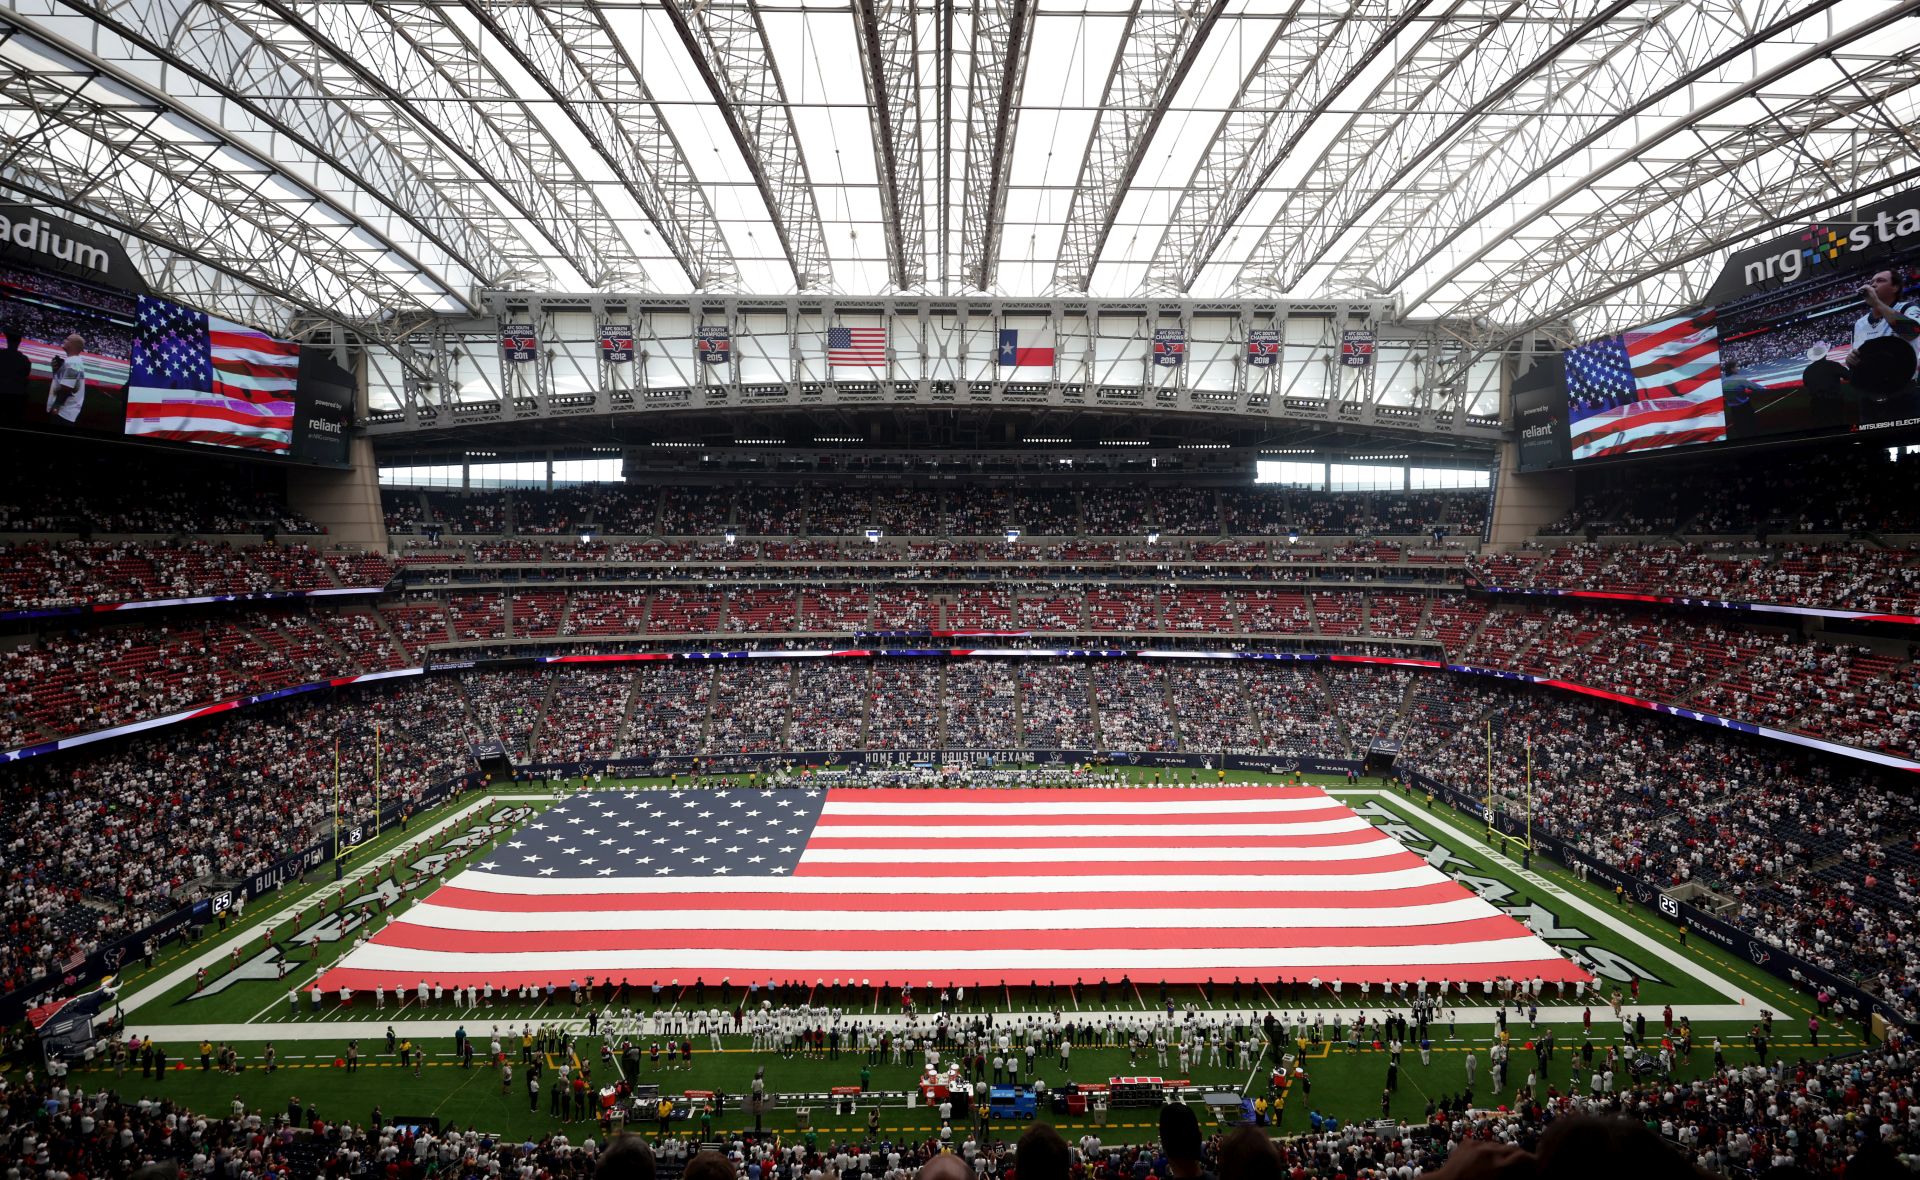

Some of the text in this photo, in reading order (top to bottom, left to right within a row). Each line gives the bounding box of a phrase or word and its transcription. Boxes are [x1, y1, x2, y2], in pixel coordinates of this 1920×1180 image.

[1744, 249, 1802, 286] nrg
[315, 400, 335, 408] powered
[1524, 406, 1542, 416] powered
[309, 418, 341, 434] reliant
[1522, 424, 1552, 438] reliant
[1859, 421, 1894, 430] MITSUBISHI
[865, 752, 893, 763] HOME
[899, 752, 912, 763] OF
[917, 752, 936, 762] THE
[942, 752, 989, 762] HOUSTON
[1418, 781, 1439, 794] TEXANS
[418, 794, 440, 807] TEXANS
[1459, 802, 1482, 817] TEXANS
[352, 830, 361, 842] 25
[256, 847, 324, 894] BULL PEN
[1474, 846, 1565, 894] END RACISM
[261, 918, 285, 927] IT
[285, 883, 345, 912] TAKES
[345, 866, 375, 880] ALL
[375, 853, 396, 862] OF
[1355, 800, 1668, 985] TEXANS
[178, 804, 536, 1003] TEXANS
[216, 894, 229, 911] 25
[1662, 897, 1675, 913] 25
[1685, 916, 1733, 945] TEXANS
